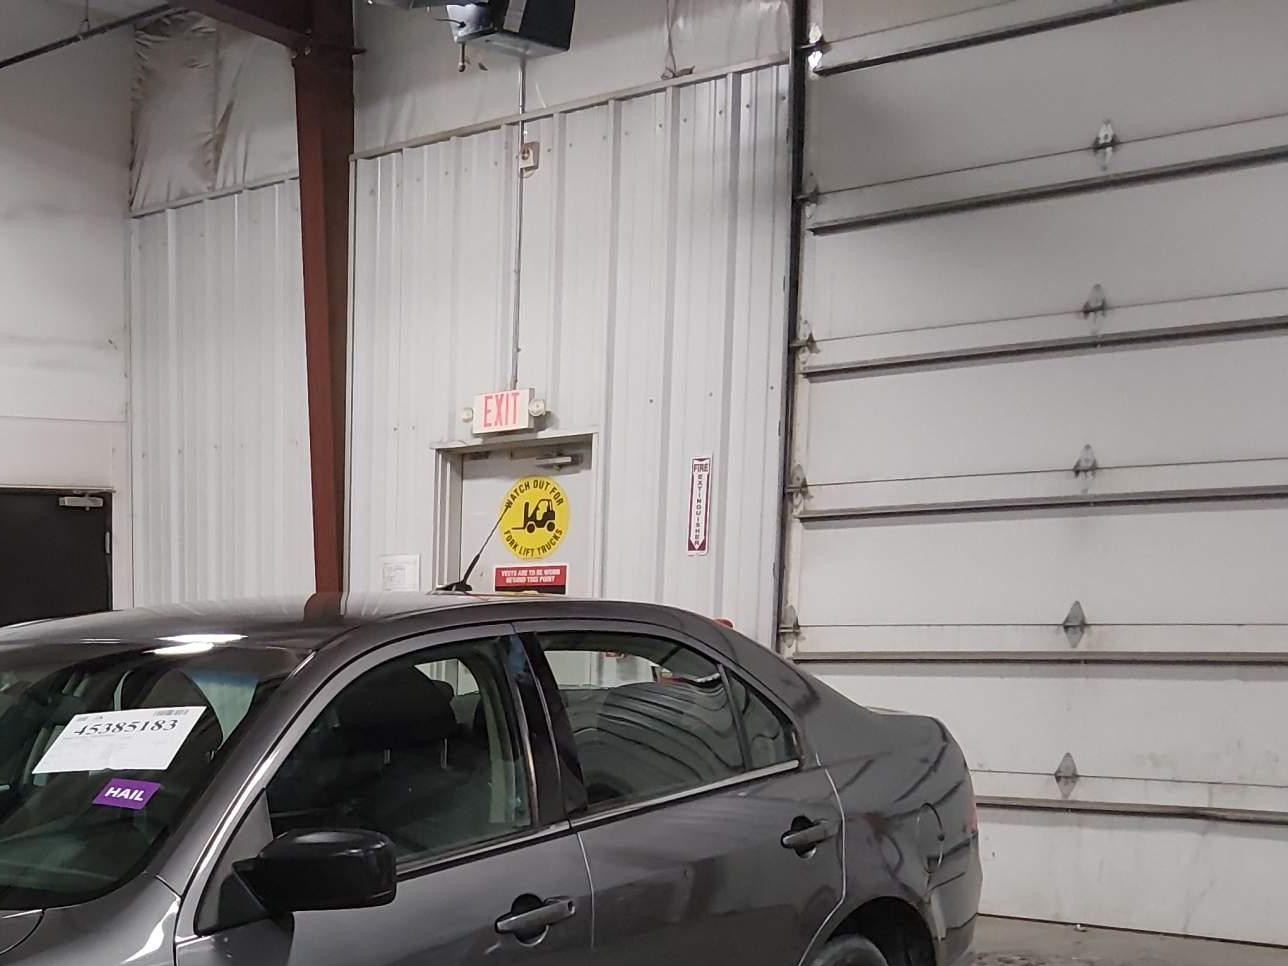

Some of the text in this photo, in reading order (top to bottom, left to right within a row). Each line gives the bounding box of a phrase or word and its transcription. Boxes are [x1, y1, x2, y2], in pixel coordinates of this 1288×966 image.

[483, 391, 520, 427] EXIT
[693, 464, 709, 473] FIRE
[505, 479, 564, 508] WATCH OUT FOR
[504, 528, 563, 557] FORK LIFT TRUCKS
[74, 719, 178, 736] 45385183
[104, 786, 145, 802] HAIL
